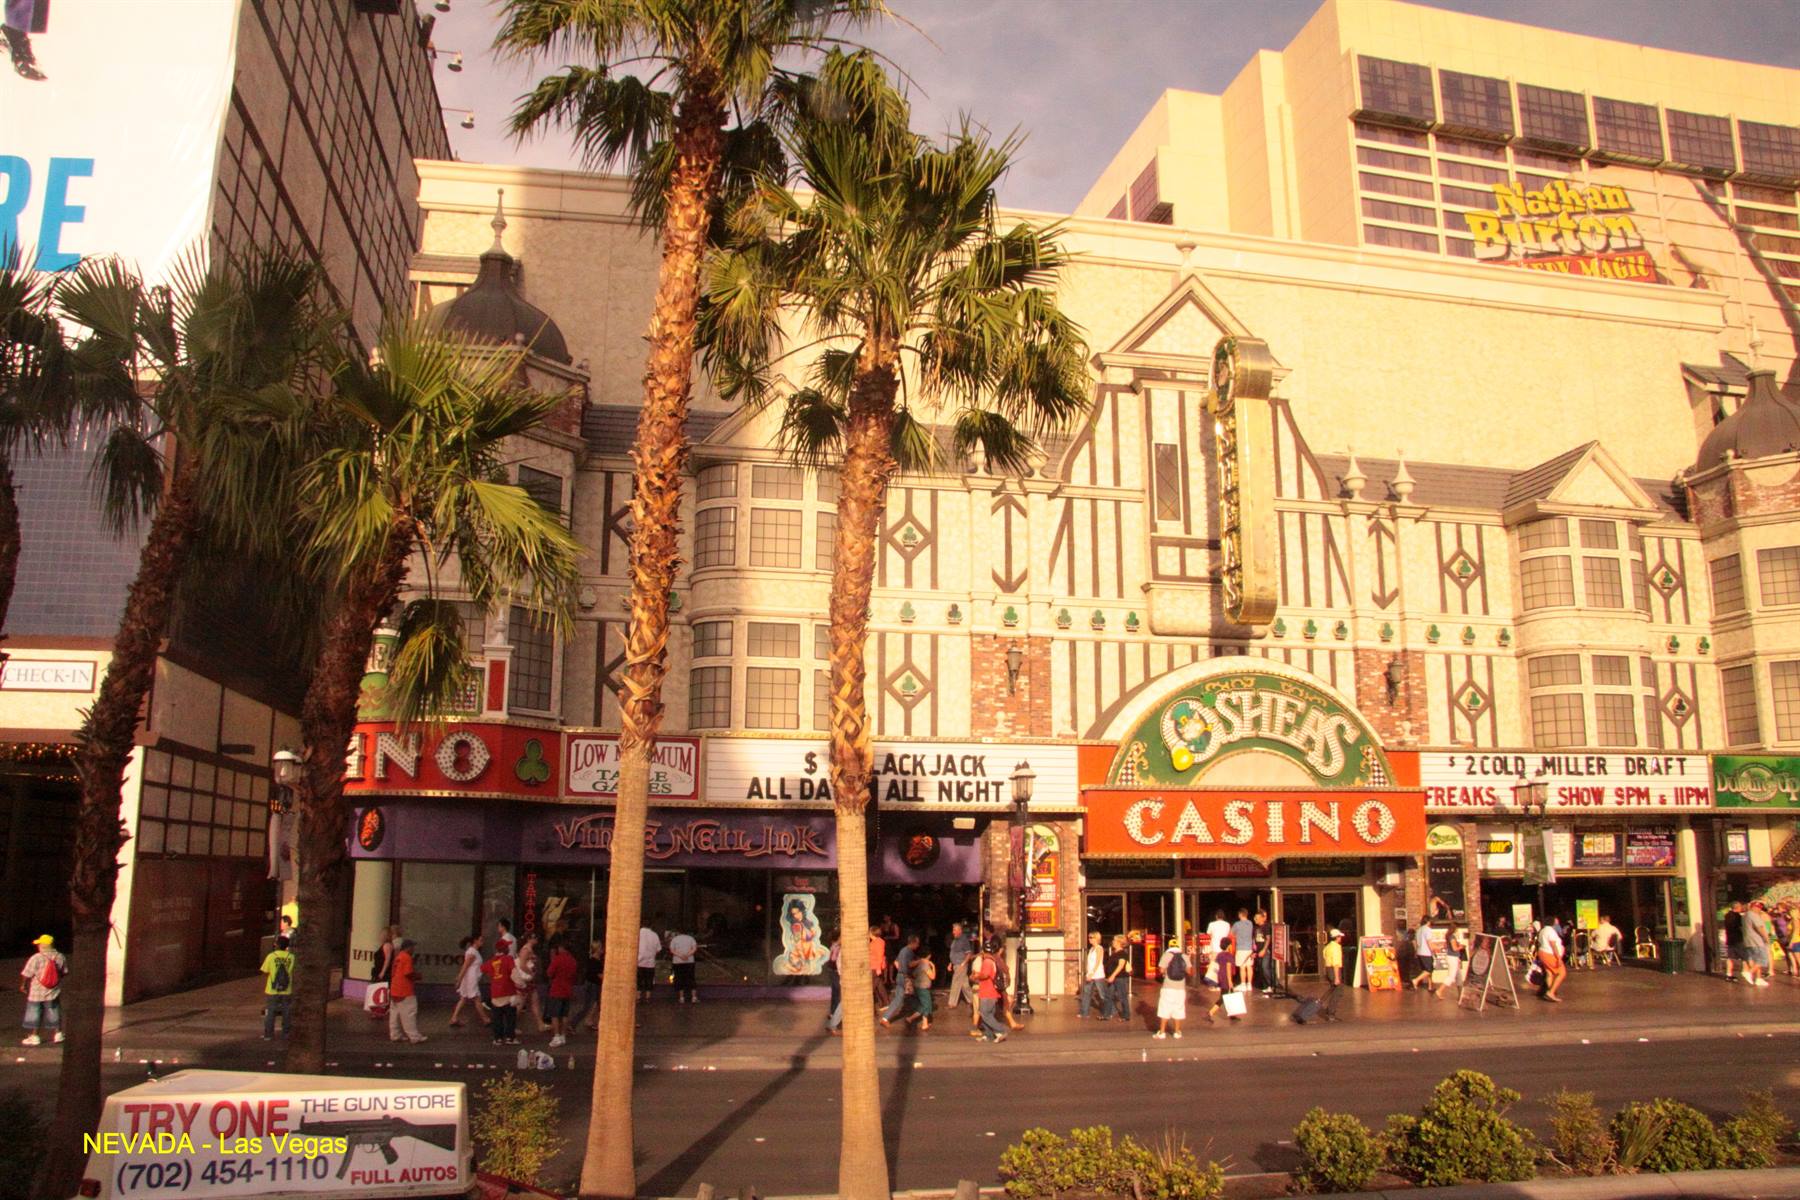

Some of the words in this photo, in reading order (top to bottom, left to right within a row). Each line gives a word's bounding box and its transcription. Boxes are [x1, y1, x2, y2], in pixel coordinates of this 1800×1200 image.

[1492, 180, 1631, 216] Nathan
[1464, 210, 1643, 259] Burton
[1578, 255, 1650, 280] MAGIC
[4, 668, 91, 683] CHECK-IN
[573, 743, 608, 772] LOW
[804, 751, 817, 775] $
[1541, 756, 1608, 776] MILLER
[1625, 756, 1687, 776] DRAFT
[592, 781, 673, 794] GAES
[747, 777, 792, 800] ALL
[800, 778, 832, 800] DA
[885, 779, 924, 802] ALL
[938, 780, 1004, 803] NIGHT
[1425, 785, 1496, 806] FREAKS
[1558, 786, 1605, 806] SHOW
[1615, 786, 1651, 806] 9PM
[1123, 798, 1396, 845] CASINO
[525, 873, 537, 932] TATTOO
[301, 1098, 339, 1113] THE
[344, 1096, 388, 1112] GUN
[394, 1094, 456, 1110] STORE
[124, 1102, 201, 1141] TRY
[209, 1100, 289, 1140] ONE
[117, 1158, 193, 1195] (702)
[201, 1156, 329, 1185] 454-1110
[351, 1170, 395, 1185] FULL
[401, 1166, 457, 1181] AUTOS
